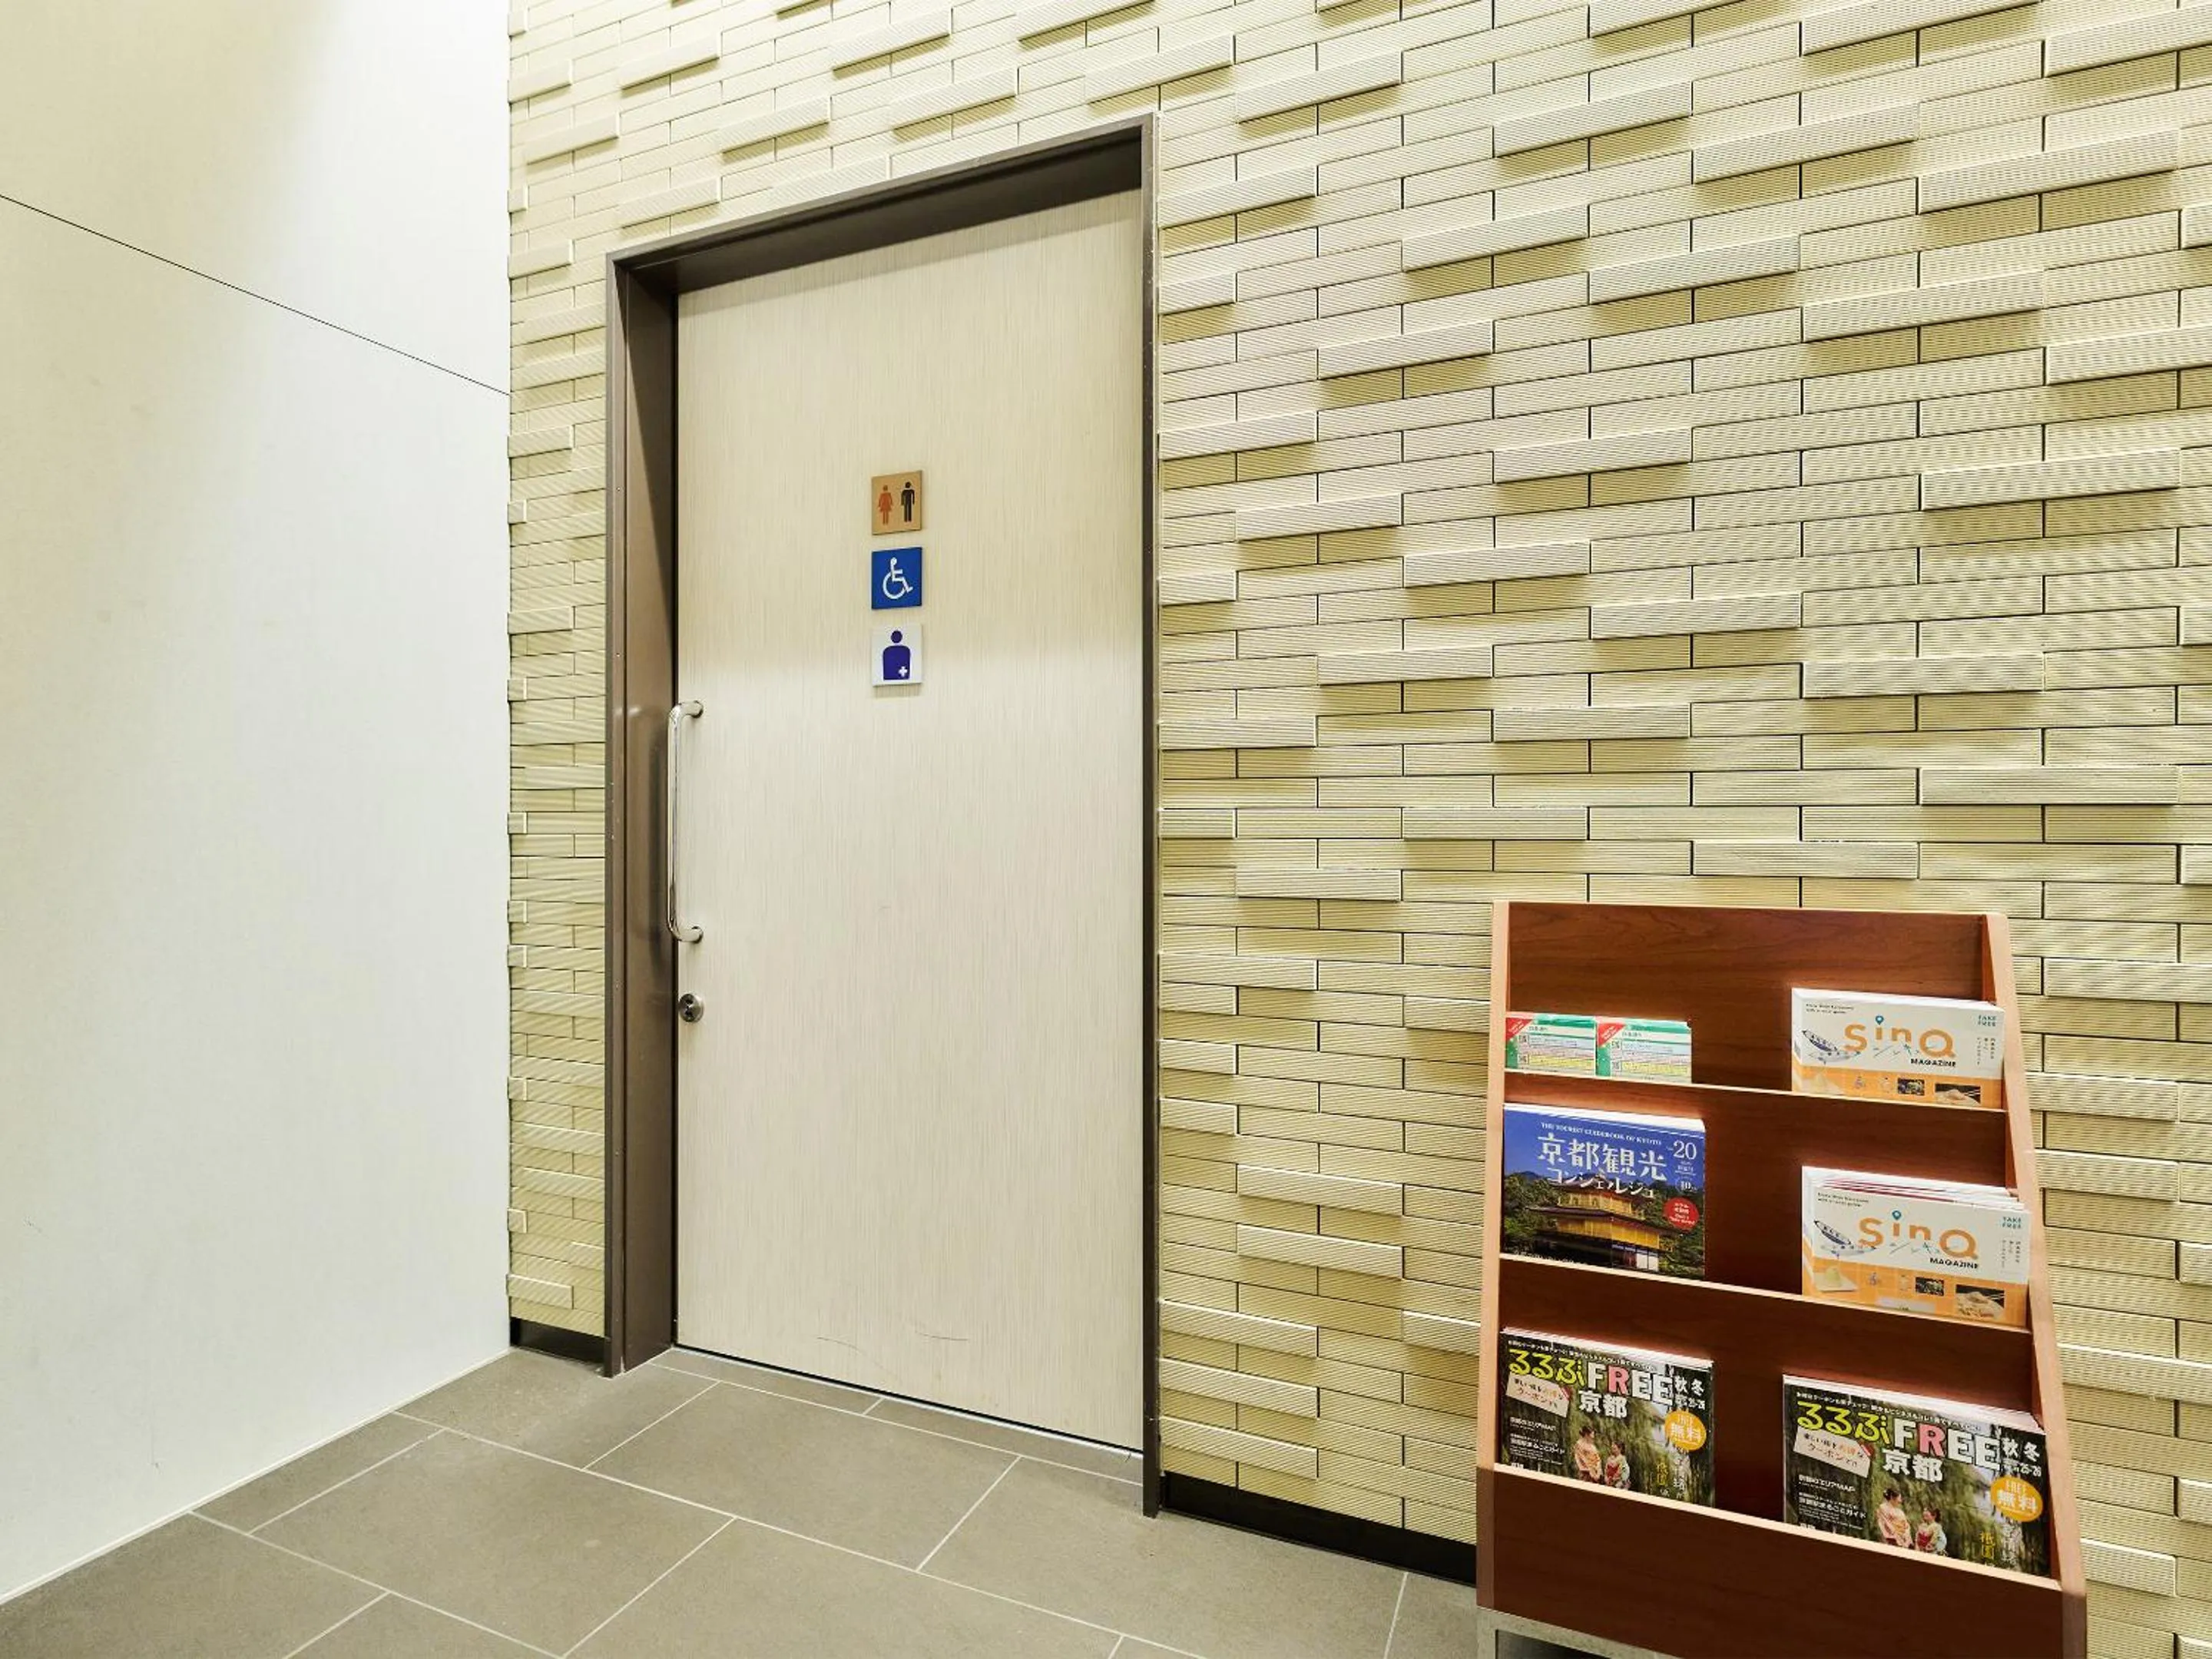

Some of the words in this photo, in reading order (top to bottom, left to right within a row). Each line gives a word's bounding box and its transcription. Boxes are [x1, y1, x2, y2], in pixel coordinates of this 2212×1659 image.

[1910, 1058, 1957, 1068] MAGAZINE
[1556, 1125, 1583, 1134] TOURIST
[1584, 1128, 1624, 1141] GUIDEBOOK
[1637, 1136, 1661, 1146] KYOTO
[1538, 1132, 1667, 1181] 京都観光
[1674, 1140, 1697, 1160] 20
[1547, 1167, 1655, 1198] コンシェルジュ
[1929, 1257, 1979, 1270] MAGAZINE
[1674, 1376, 1704, 1396] 秋冬
[1578, 1390, 1628, 1419] 京都
[2002, 1437, 2040, 1462] 秋冬
[1883, 1449, 1943, 1482] 京都
[1996, 1489, 2037, 1512] 無料
